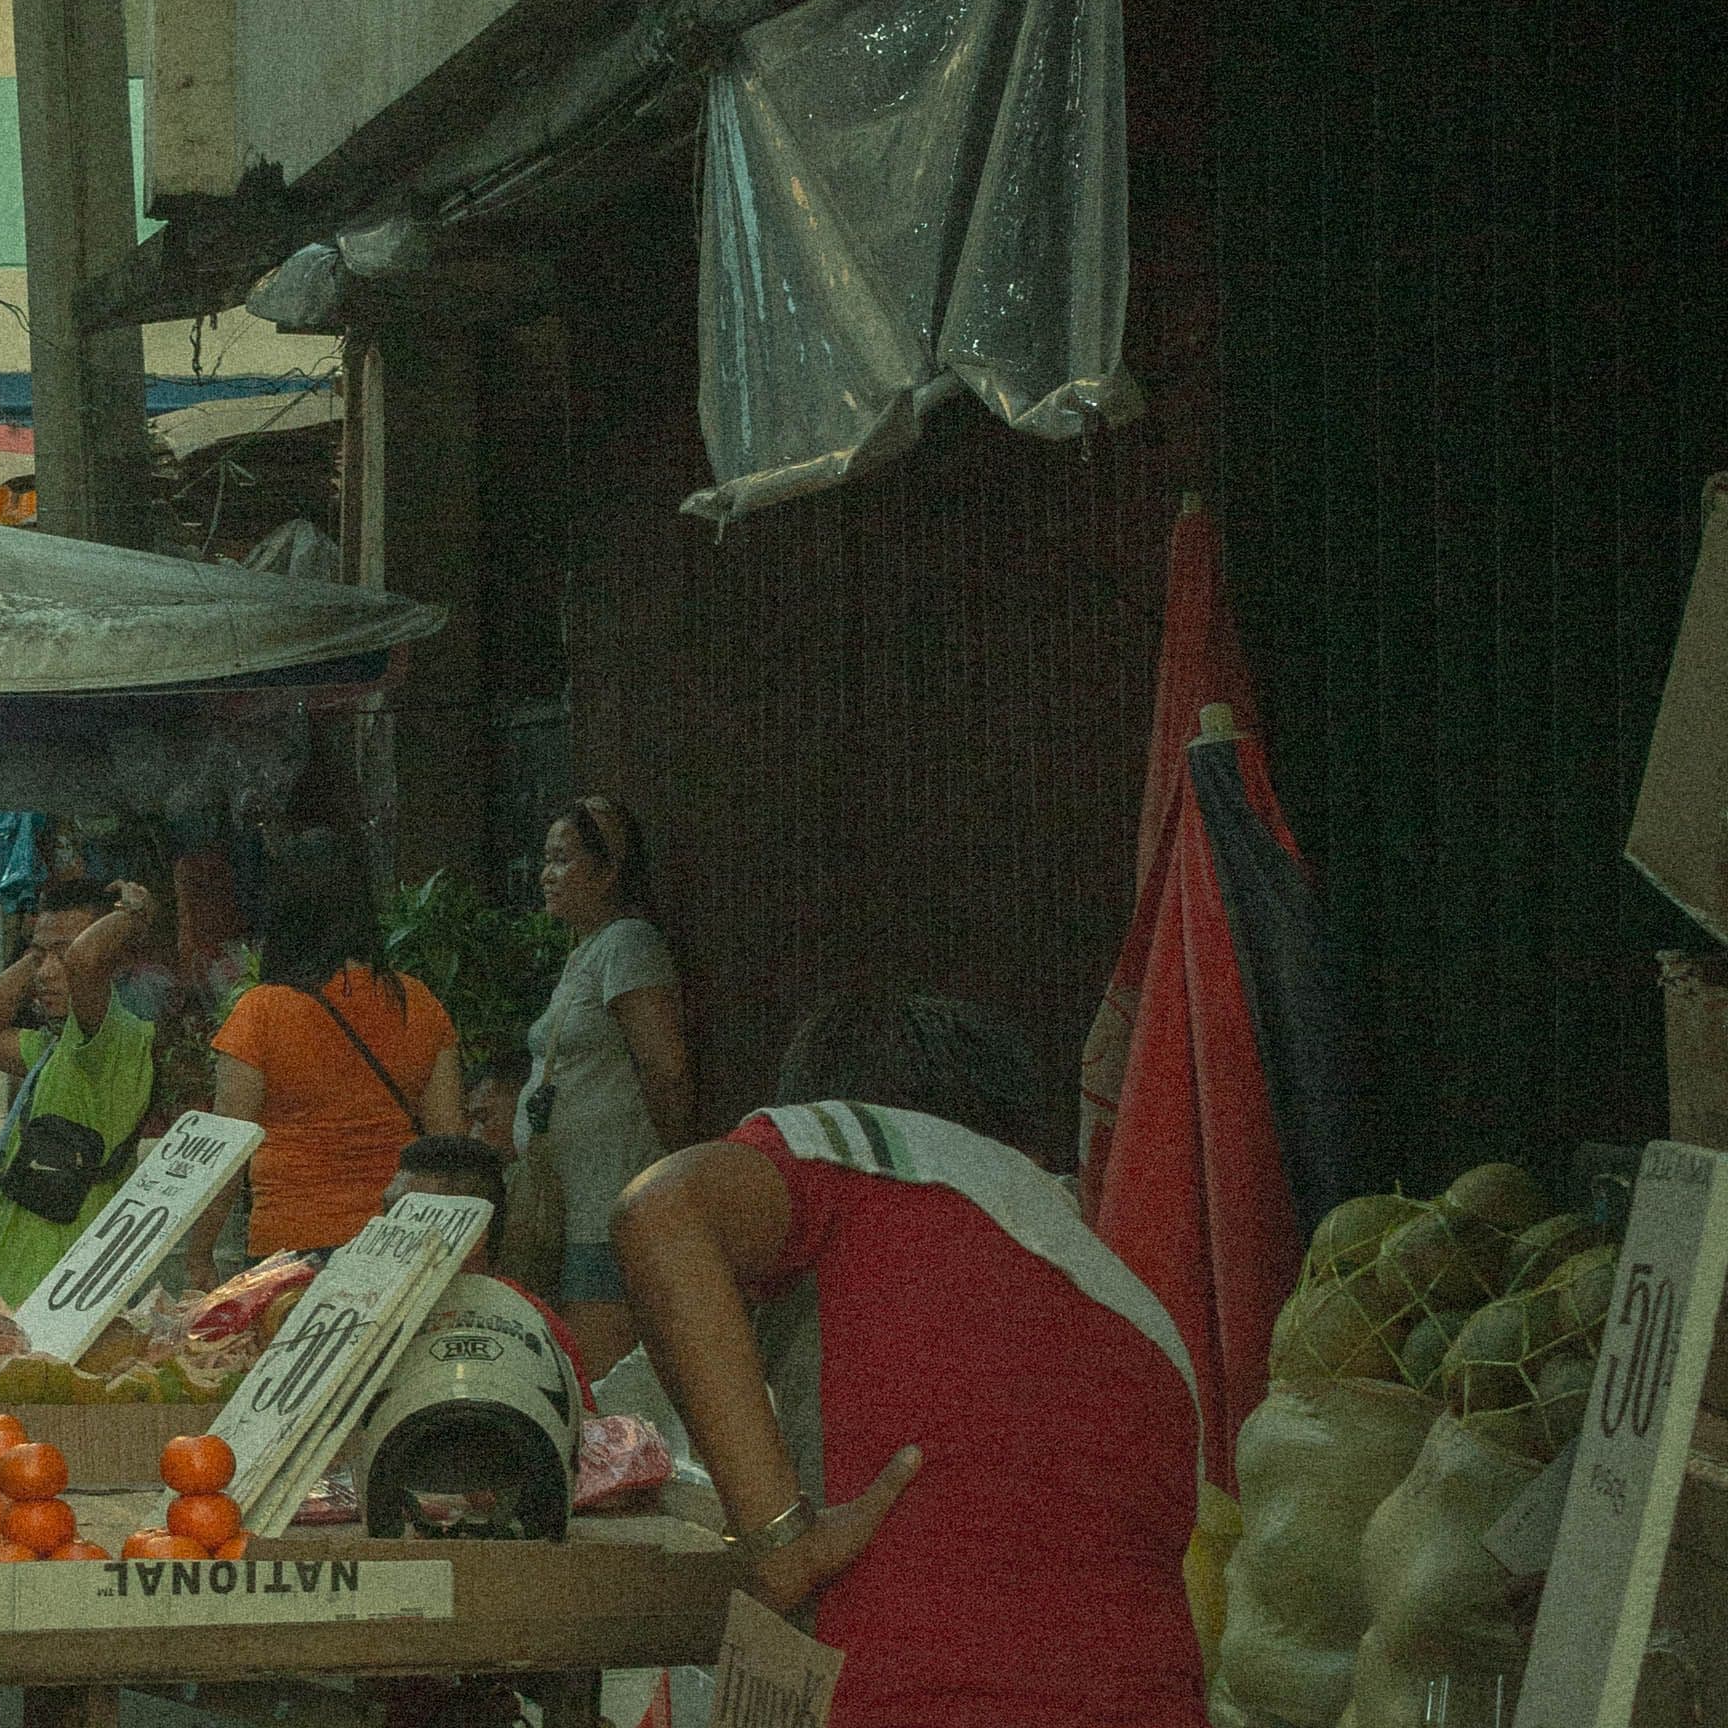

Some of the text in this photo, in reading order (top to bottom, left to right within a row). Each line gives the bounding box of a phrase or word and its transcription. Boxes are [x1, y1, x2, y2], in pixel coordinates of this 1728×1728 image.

[48, 1198, 169, 1312] 50
[252, 1304, 360, 1416] 50
[1600, 1262, 1676, 1440] 50
